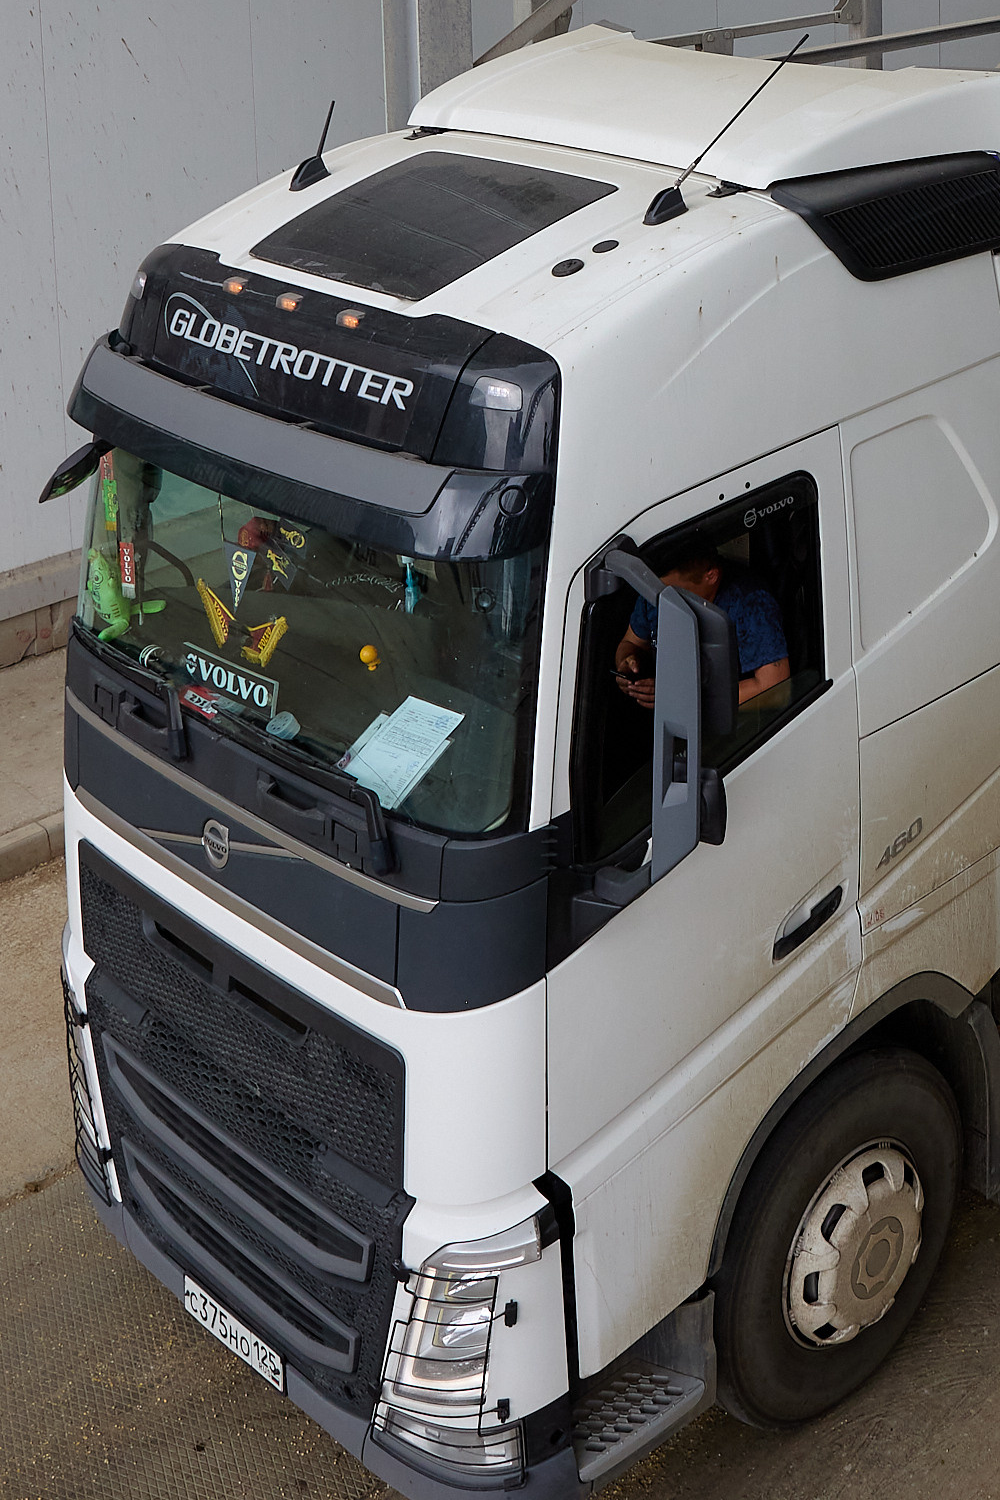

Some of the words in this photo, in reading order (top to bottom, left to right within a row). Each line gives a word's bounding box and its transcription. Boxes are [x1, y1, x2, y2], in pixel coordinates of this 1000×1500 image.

[169, 308, 414, 411] GLOBETROTTER
[757, 496, 794, 517] VOLVO
[123, 548, 132, 583] VOLVO
[198, 657, 269, 708] VOLVO
[204, 835, 227, 854] VOLVO
[875, 817, 923, 871] 460
[190, 1292, 250, 1357] C375HO
[253, 1340, 278, 1372] 125
